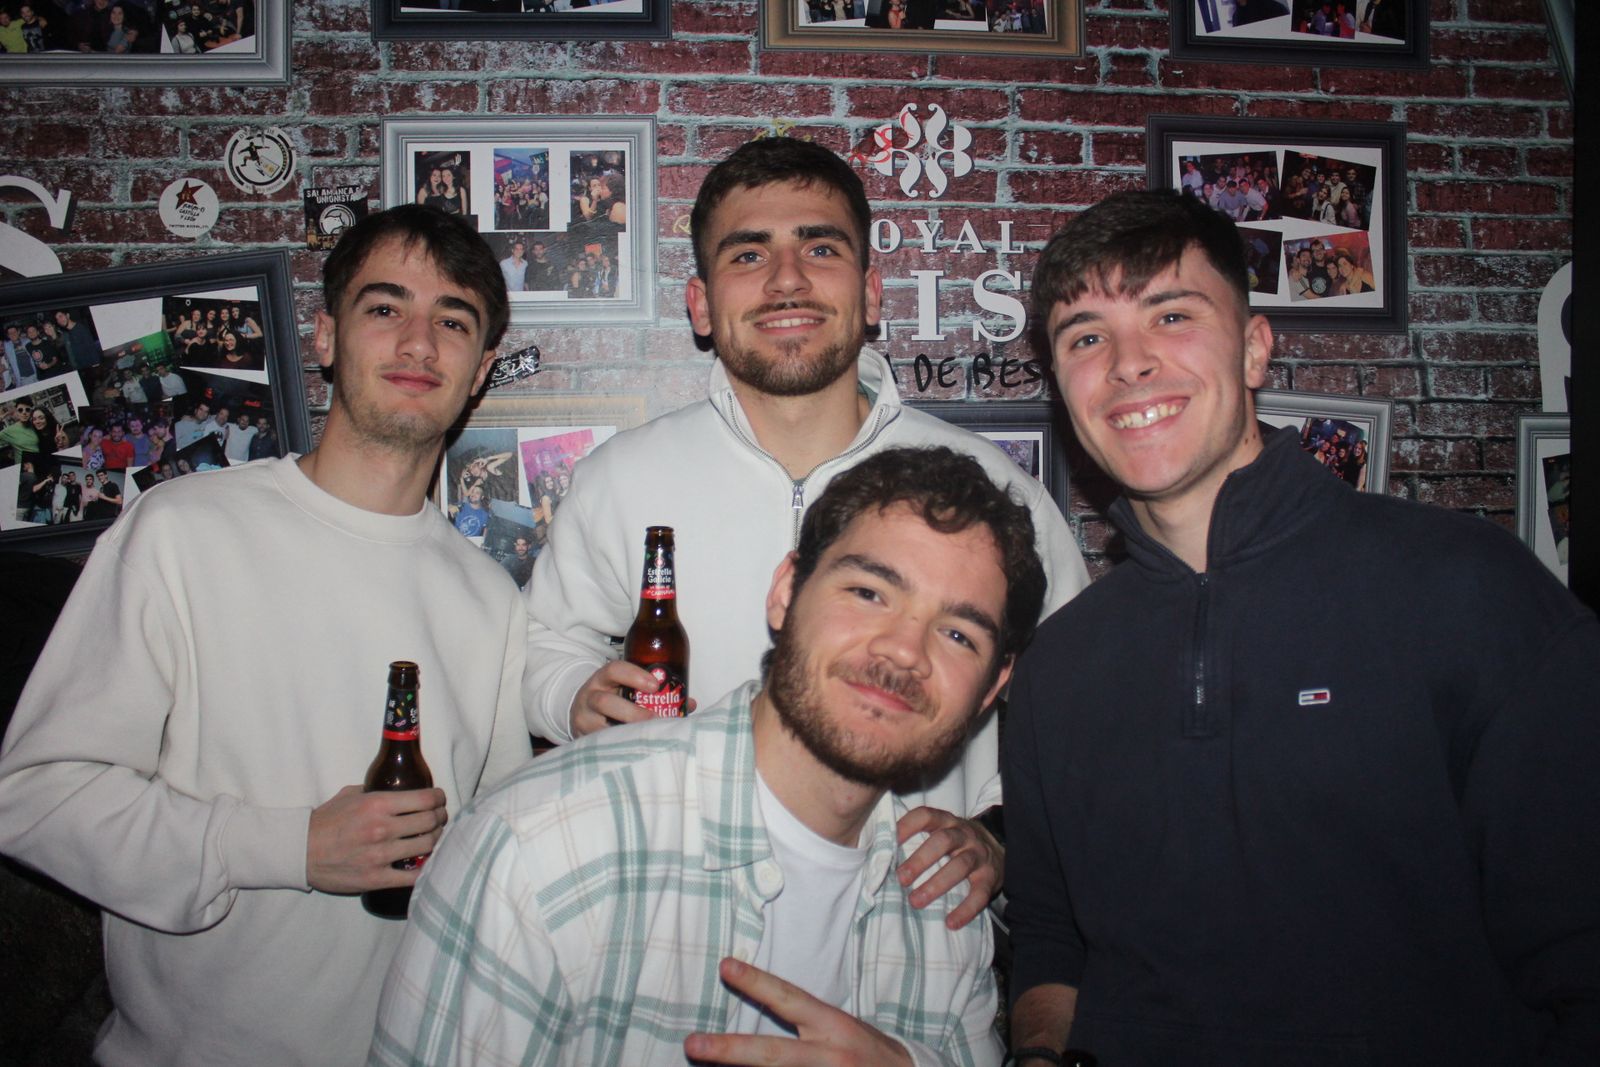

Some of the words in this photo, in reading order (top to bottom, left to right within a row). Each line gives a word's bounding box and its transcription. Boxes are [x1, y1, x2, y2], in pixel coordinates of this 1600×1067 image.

[306, 187, 354, 198] SALAMANCA
[870, 218, 1024, 254] OYAL
[877, 269, 1027, 342] IS
[914, 353, 957, 392] DE
[647, 568, 673, 576] Estrella
[647, 575, 672, 584] Galicia
[634, 691, 681, 706] Estrella
